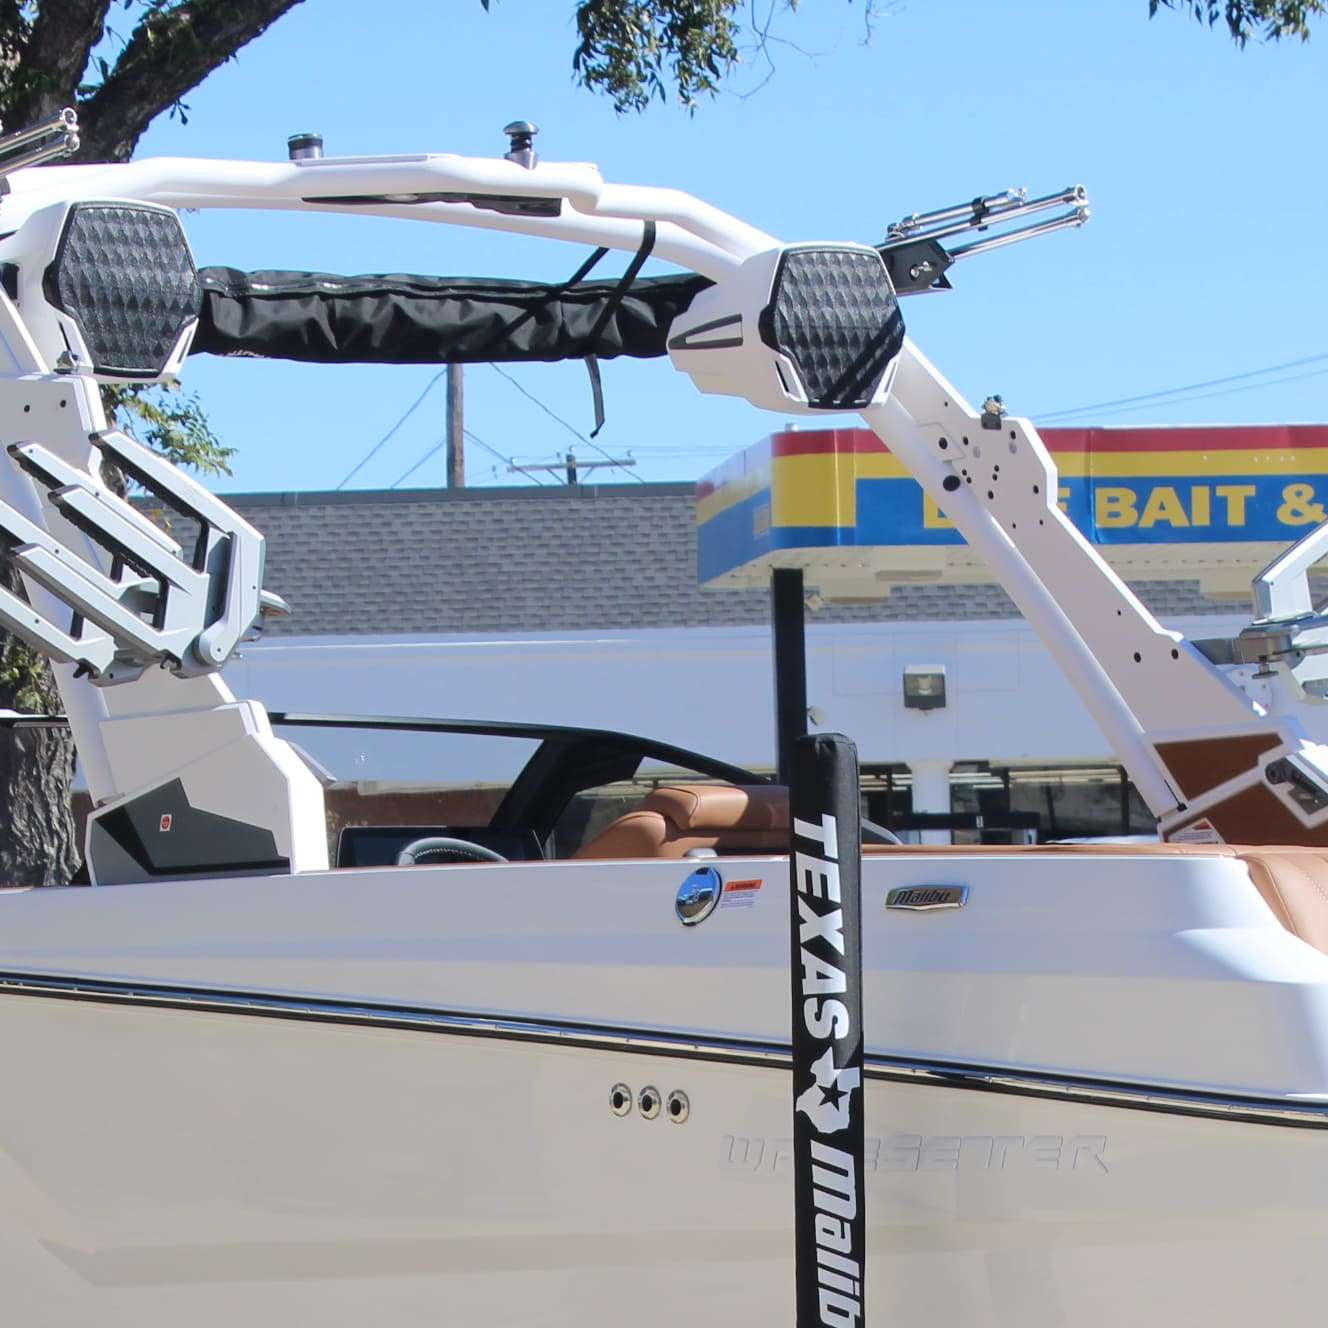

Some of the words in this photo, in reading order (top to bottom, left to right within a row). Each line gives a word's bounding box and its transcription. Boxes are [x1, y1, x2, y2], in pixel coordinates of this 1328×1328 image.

[1094, 484, 1257, 528] BAIT
[793, 813, 851, 1041] TEXAS
[719, 1133, 1112, 1176] WASETTER
